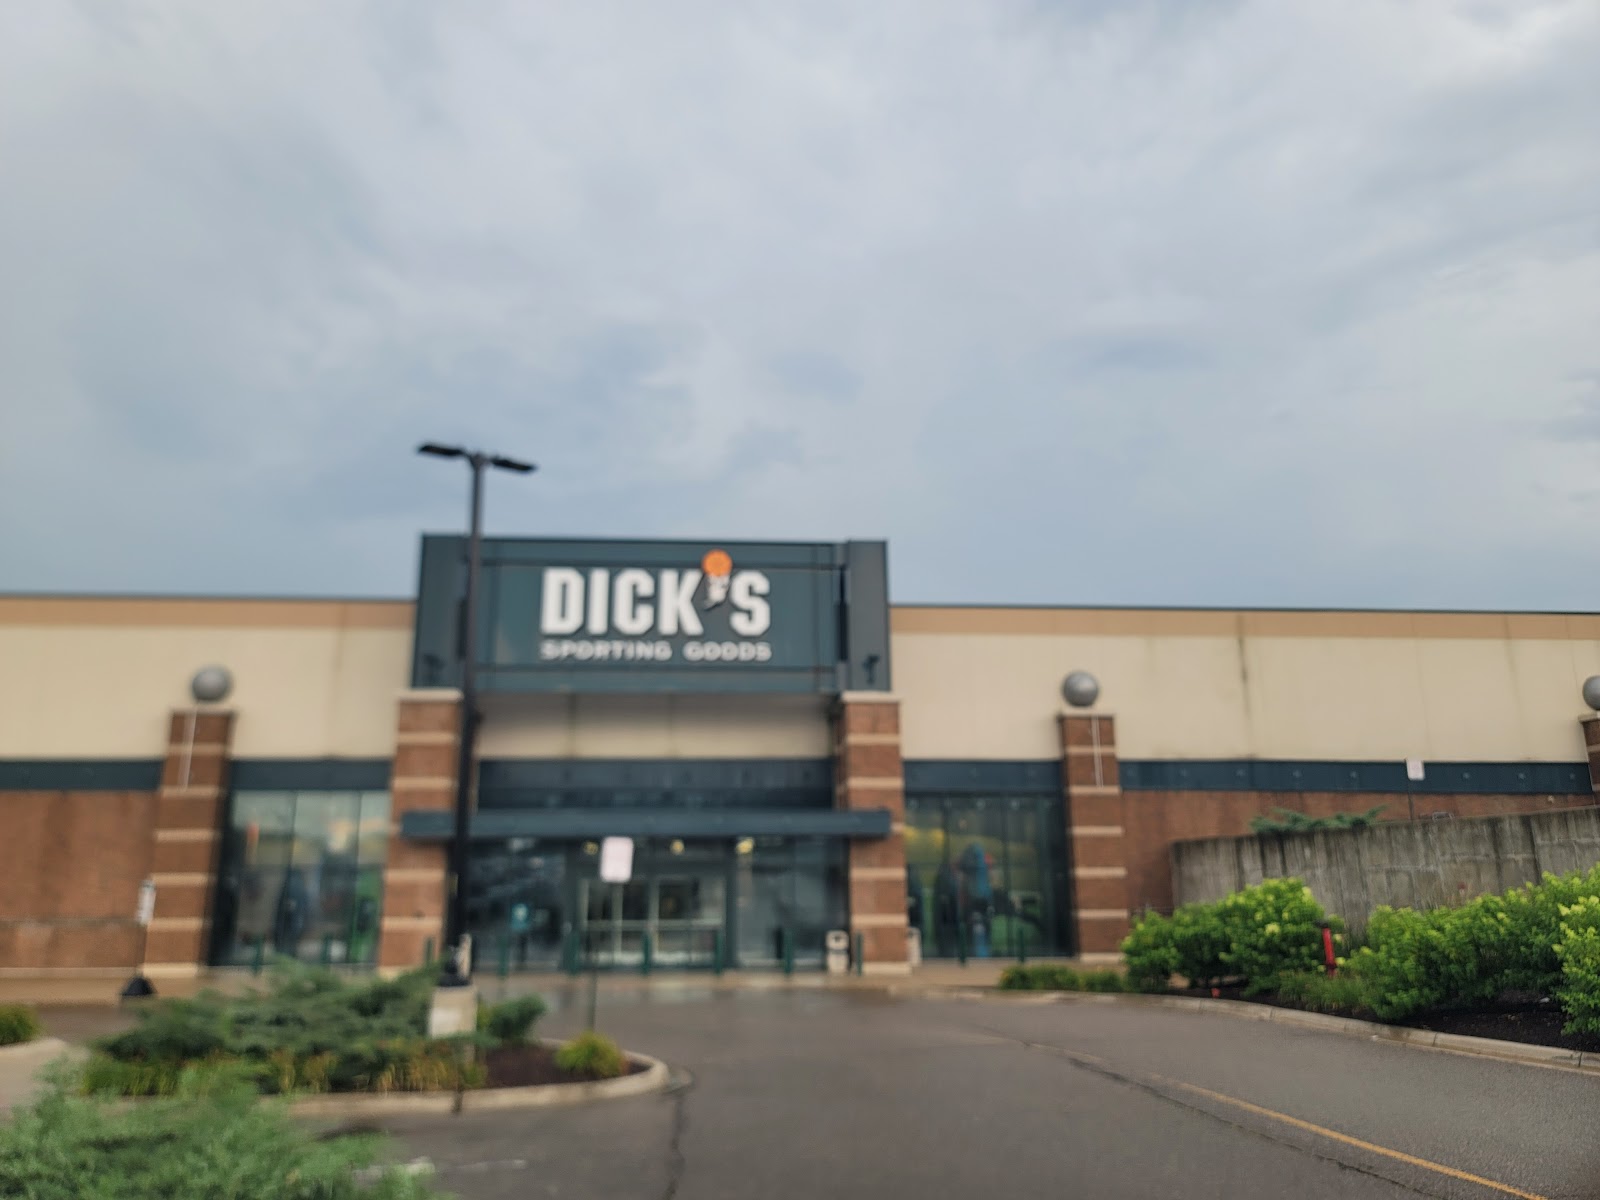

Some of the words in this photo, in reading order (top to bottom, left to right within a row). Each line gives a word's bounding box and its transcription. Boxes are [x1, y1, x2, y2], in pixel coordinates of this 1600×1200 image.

[540, 550, 771, 636] DICK'S
[540, 639, 673, 661] SPORTING
[684, 641, 772, 662] GOODS
